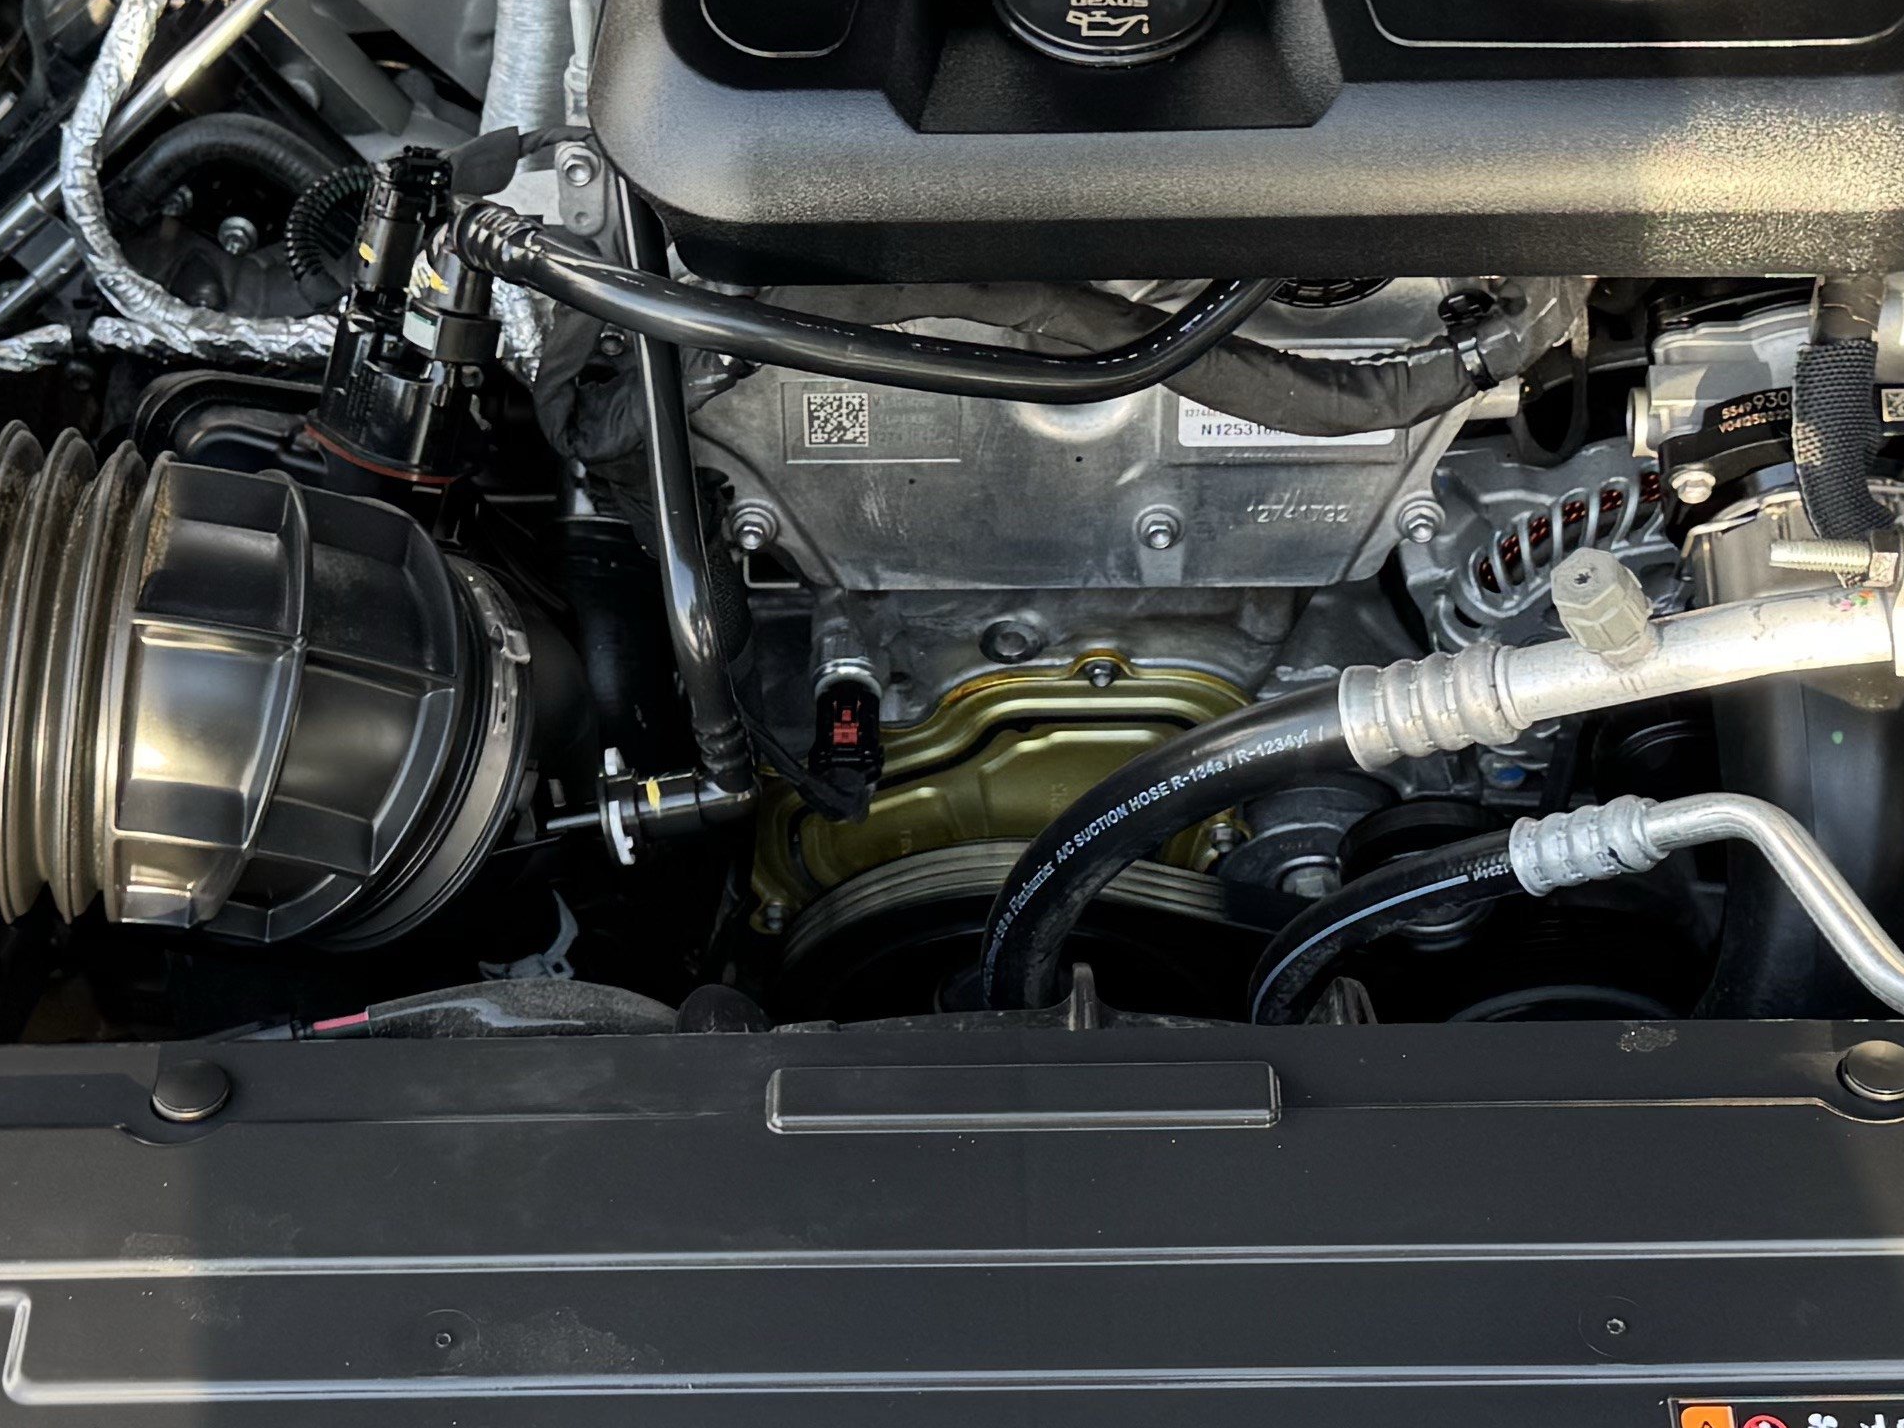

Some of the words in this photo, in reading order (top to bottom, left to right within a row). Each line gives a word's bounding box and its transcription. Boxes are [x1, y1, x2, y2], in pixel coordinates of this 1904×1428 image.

[1074, 804, 1127, 847] SUCTION
[1128, 781, 1169, 812] HOSE
[1171, 758, 1225, 790] R-134a
[1237, 728, 1310, 764] R-1234yf
